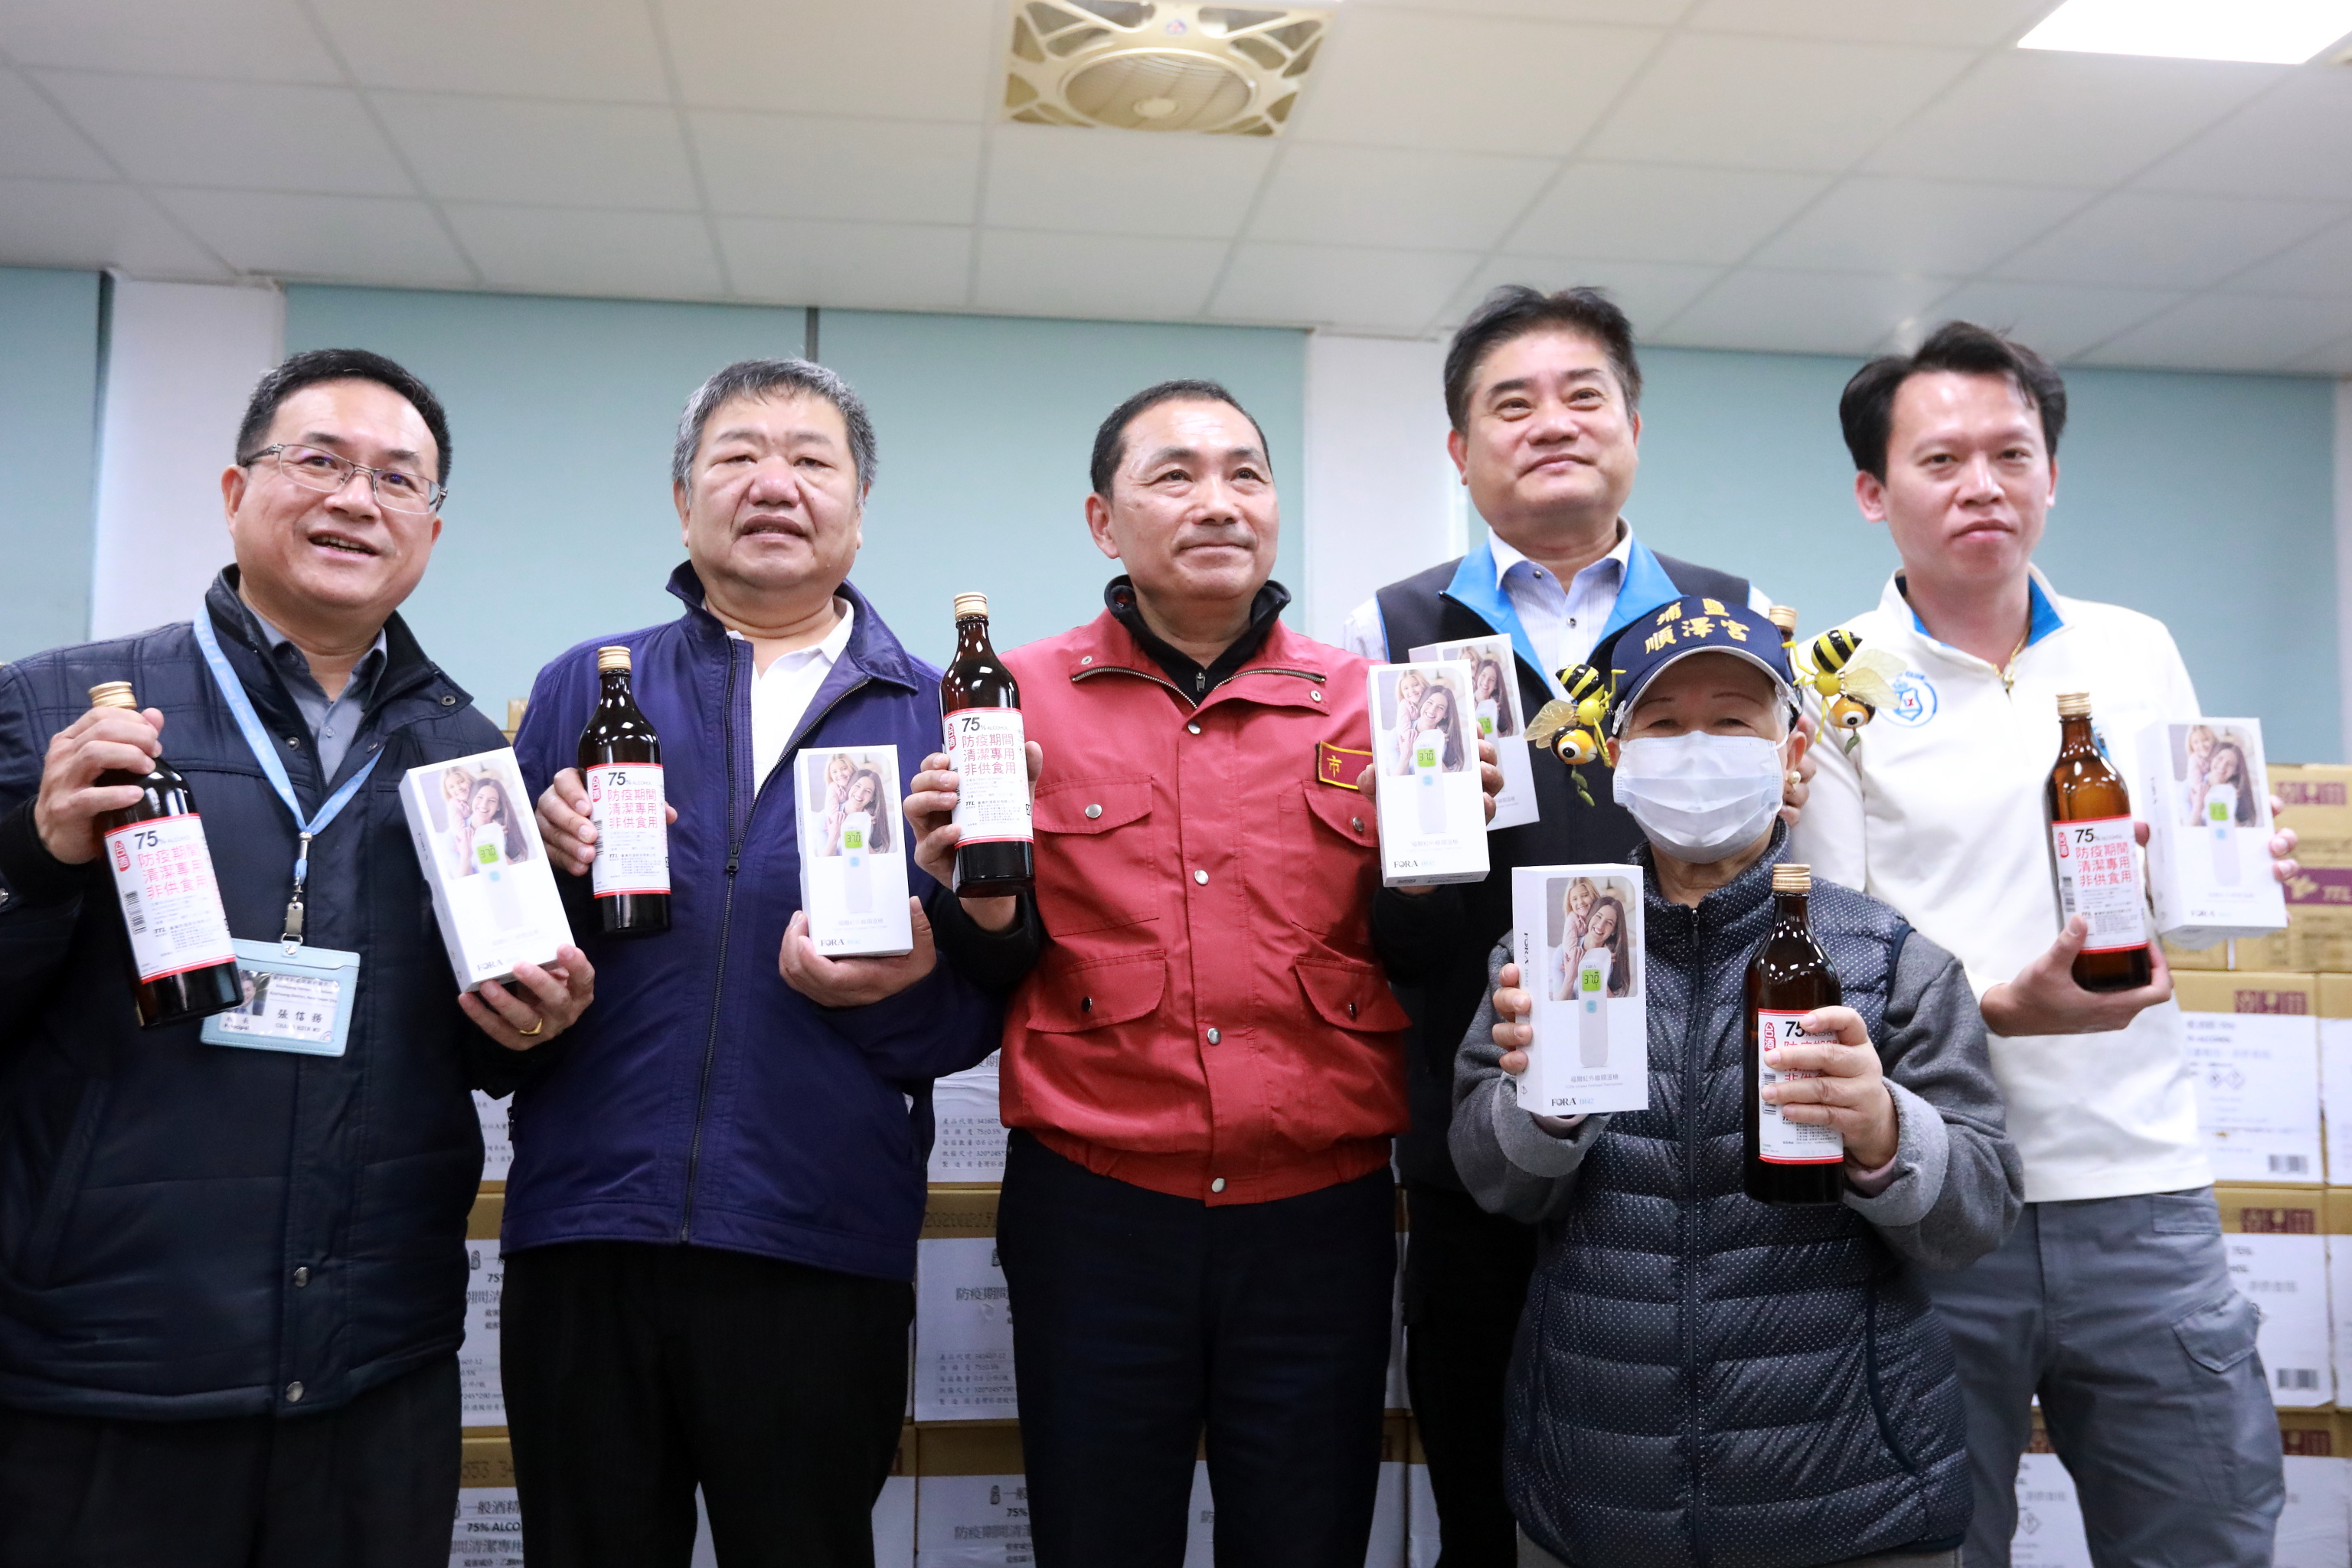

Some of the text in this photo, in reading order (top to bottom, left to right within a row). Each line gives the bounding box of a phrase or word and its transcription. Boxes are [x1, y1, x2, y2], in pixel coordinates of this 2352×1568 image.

[1645, 616, 1749, 654] 順澤宮
[962, 733, 1014, 748] 防疫期間
[963, 747, 1015, 763] 清潔專用
[965, 761, 1016, 776] 非供食用
[1327, 755, 1342, 777] 市
[608, 789, 657, 802] 防疫期間
[609, 802, 658, 815] 清潔專用
[609, 815, 658, 829] 非供食用
[138, 843, 201, 868] 防疫期間
[2076, 841, 2129, 859] 防疫期間
[142, 859, 204, 884] 清潔專用
[1393, 860, 1419, 869] FORA
[2078, 855, 2131, 874] 清潔專用
[2079, 870, 2132, 887] 非供食用
[147, 875, 208, 900] 非供食用
[821, 939, 844, 947] FORA
[477, 959, 504, 972] FORA
[1584, 973, 1599, 985] 37.0
[1551, 1097, 1577, 1106] FORA
[467, 1522, 489, 1532] 75%
